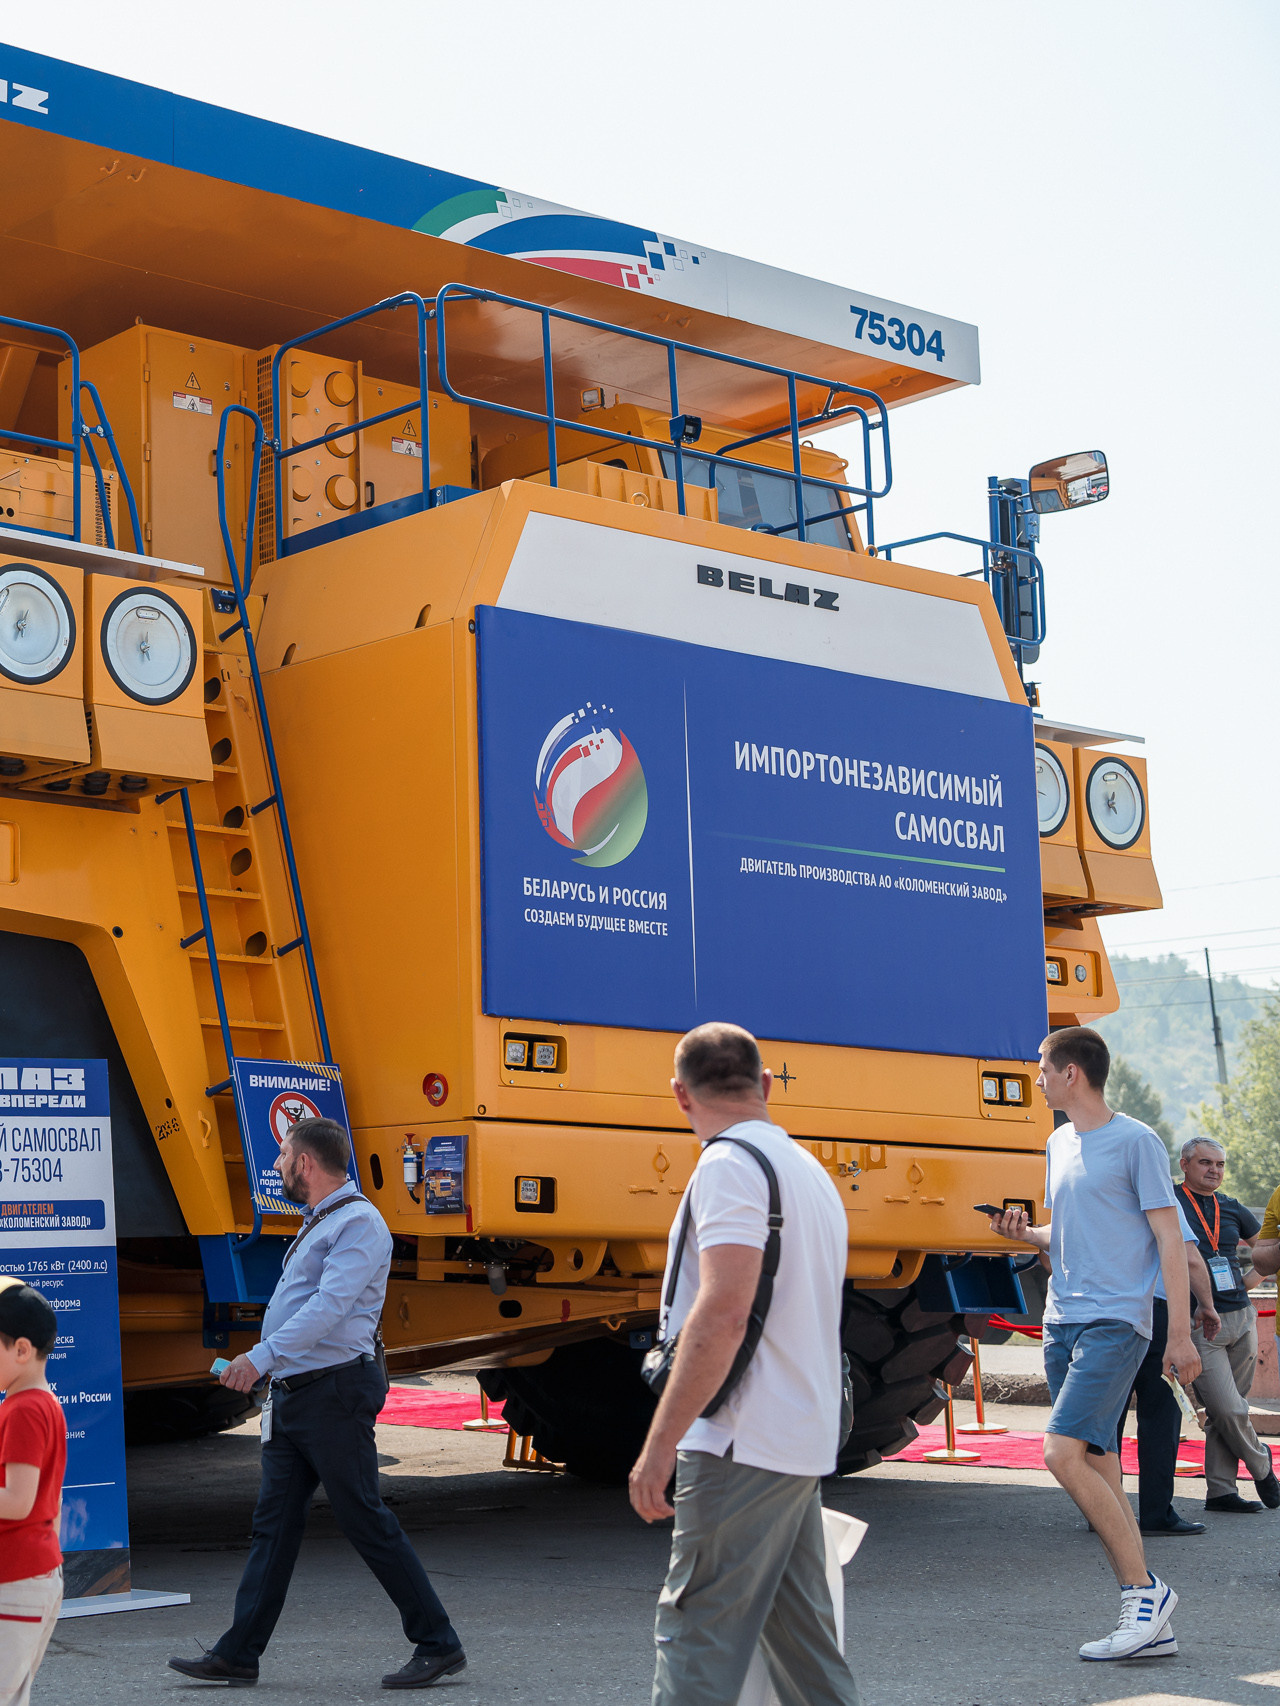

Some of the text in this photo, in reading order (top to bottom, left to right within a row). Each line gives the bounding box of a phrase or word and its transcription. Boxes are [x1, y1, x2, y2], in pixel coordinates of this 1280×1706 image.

[849, 304, 945, 363] 75304
[696, 563, 841, 613] BELAZ
[734, 740, 1003, 808] ИМПОРТОНЕЗАВИСИМЫЙ
[895, 811, 1005, 854] САМОСВАЛ
[739, 857, 1008, 904] ДВИГАТЕЛЬ ПРОИЗВОДСТВА АО «КОЛОМЕНСКИЙ ЗАВОД»
[523, 876, 668, 911] БЕЛАРУСЬ И РОССИЯ
[524, 908, 669, 937] СОЗДАЕМ БУДУЩЕЕ ВМЕСТЕ
[249, 1074, 331, 1092] ВНИМАНИЕ!
[12, 1127, 102, 1152] САМОСВАЛ
[262, 1169, 281, 1177] КАРЬ
[259, 1178, 283, 1187] ПОДНИ
[272, 1188, 283, 1196] ЦЕ
[1, 1203, 54, 1217] ДВИГАТЕЛЕМ
[0, 1214, 60, 1229] «КОЛОМЕНСКИЙ
[62, 1215, 91, 1228] ЗАВОД»
[27, 1261, 48, 1272] 1765
[51, 1260, 65, 1271] кВт
[68, 1259, 92, 1272] (2400
[94, 1259, 108, 1271] л.с)
[42, 1280, 64, 1289] ресурс
[48, 1298, 81, 1309] тформа
[54, 1335, 74, 1345] еска
[47, 1352, 67, 1361] тация
[71, 1395, 78, 1404] и
[79, 1391, 112, 1403] России
[65, 1430, 86, 1439] ание
